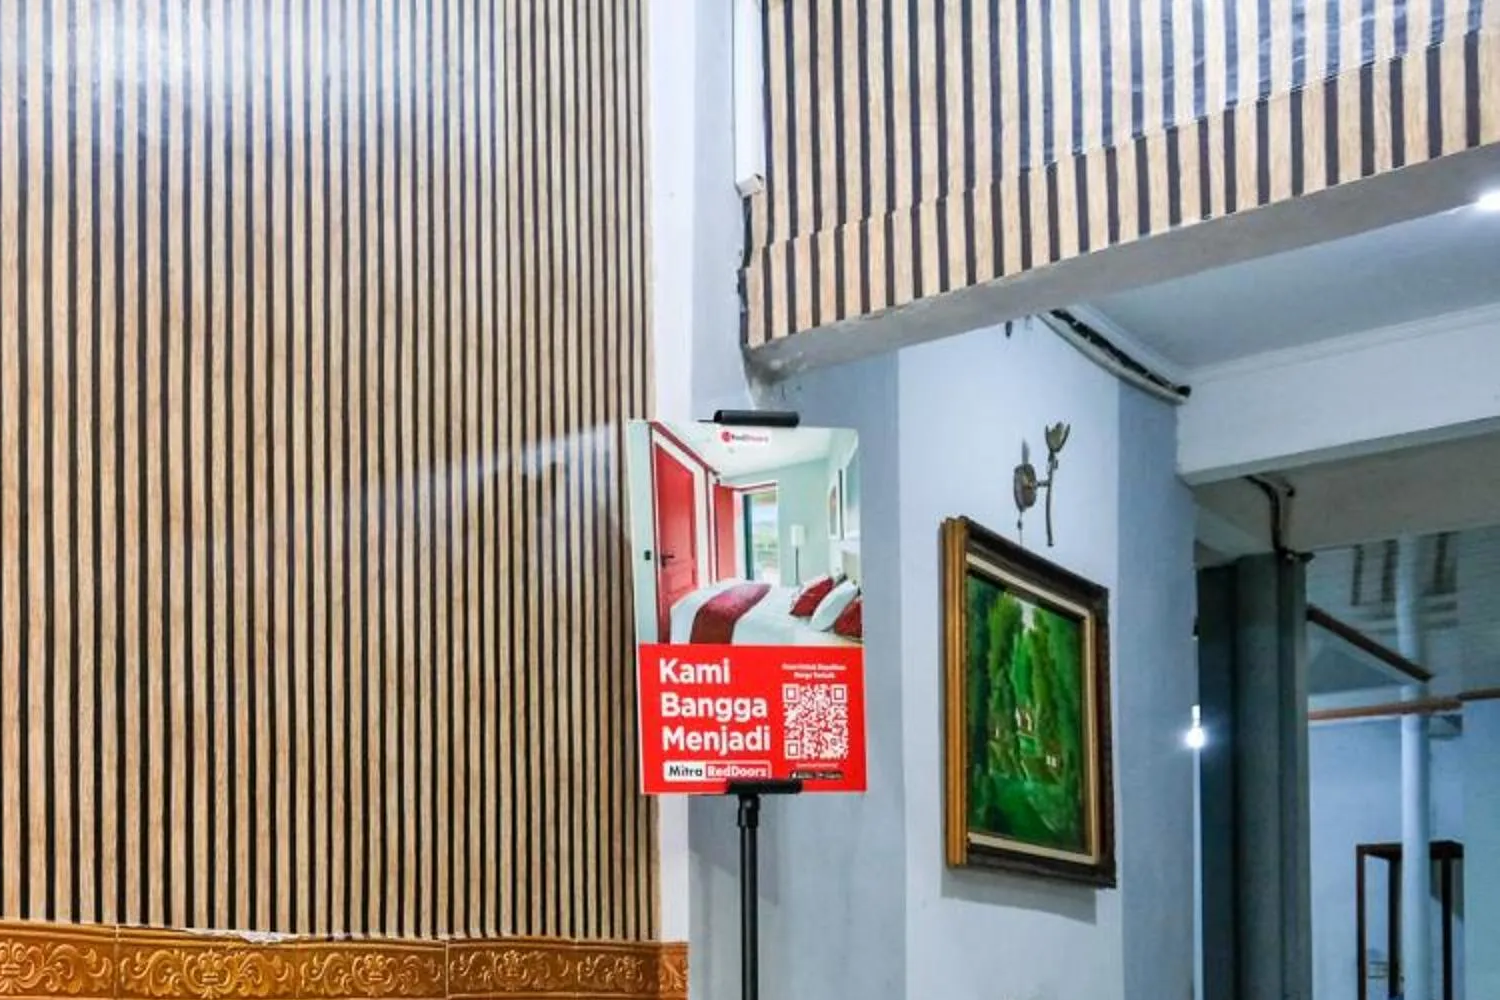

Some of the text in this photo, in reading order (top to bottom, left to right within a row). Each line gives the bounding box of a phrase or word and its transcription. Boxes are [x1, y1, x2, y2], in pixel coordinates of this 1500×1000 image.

[659, 657, 730, 685] Kami
[661, 691, 767, 722] Bangga
[662, 725, 771, 756] Menjadi
[668, 764, 703, 777] Mitra
